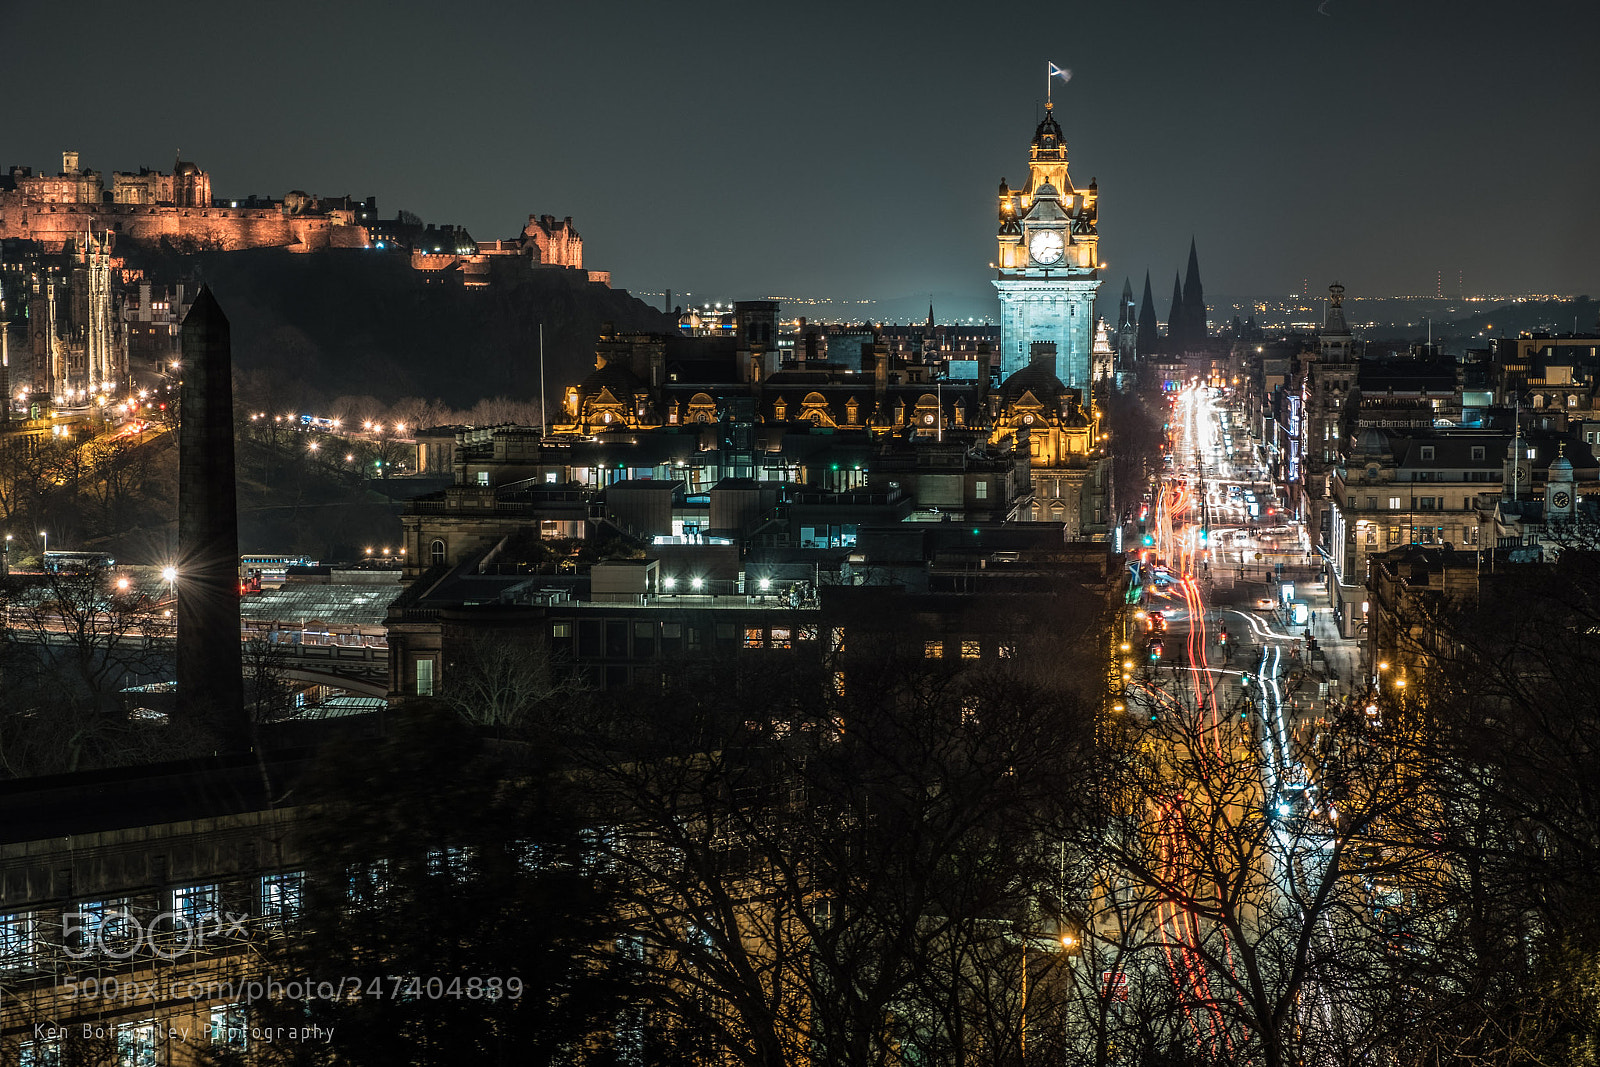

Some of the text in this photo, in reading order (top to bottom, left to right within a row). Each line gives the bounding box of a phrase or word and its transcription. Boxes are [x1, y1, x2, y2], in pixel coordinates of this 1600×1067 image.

[1358, 419, 1433, 428] ROYL BRITISH HOTEL
